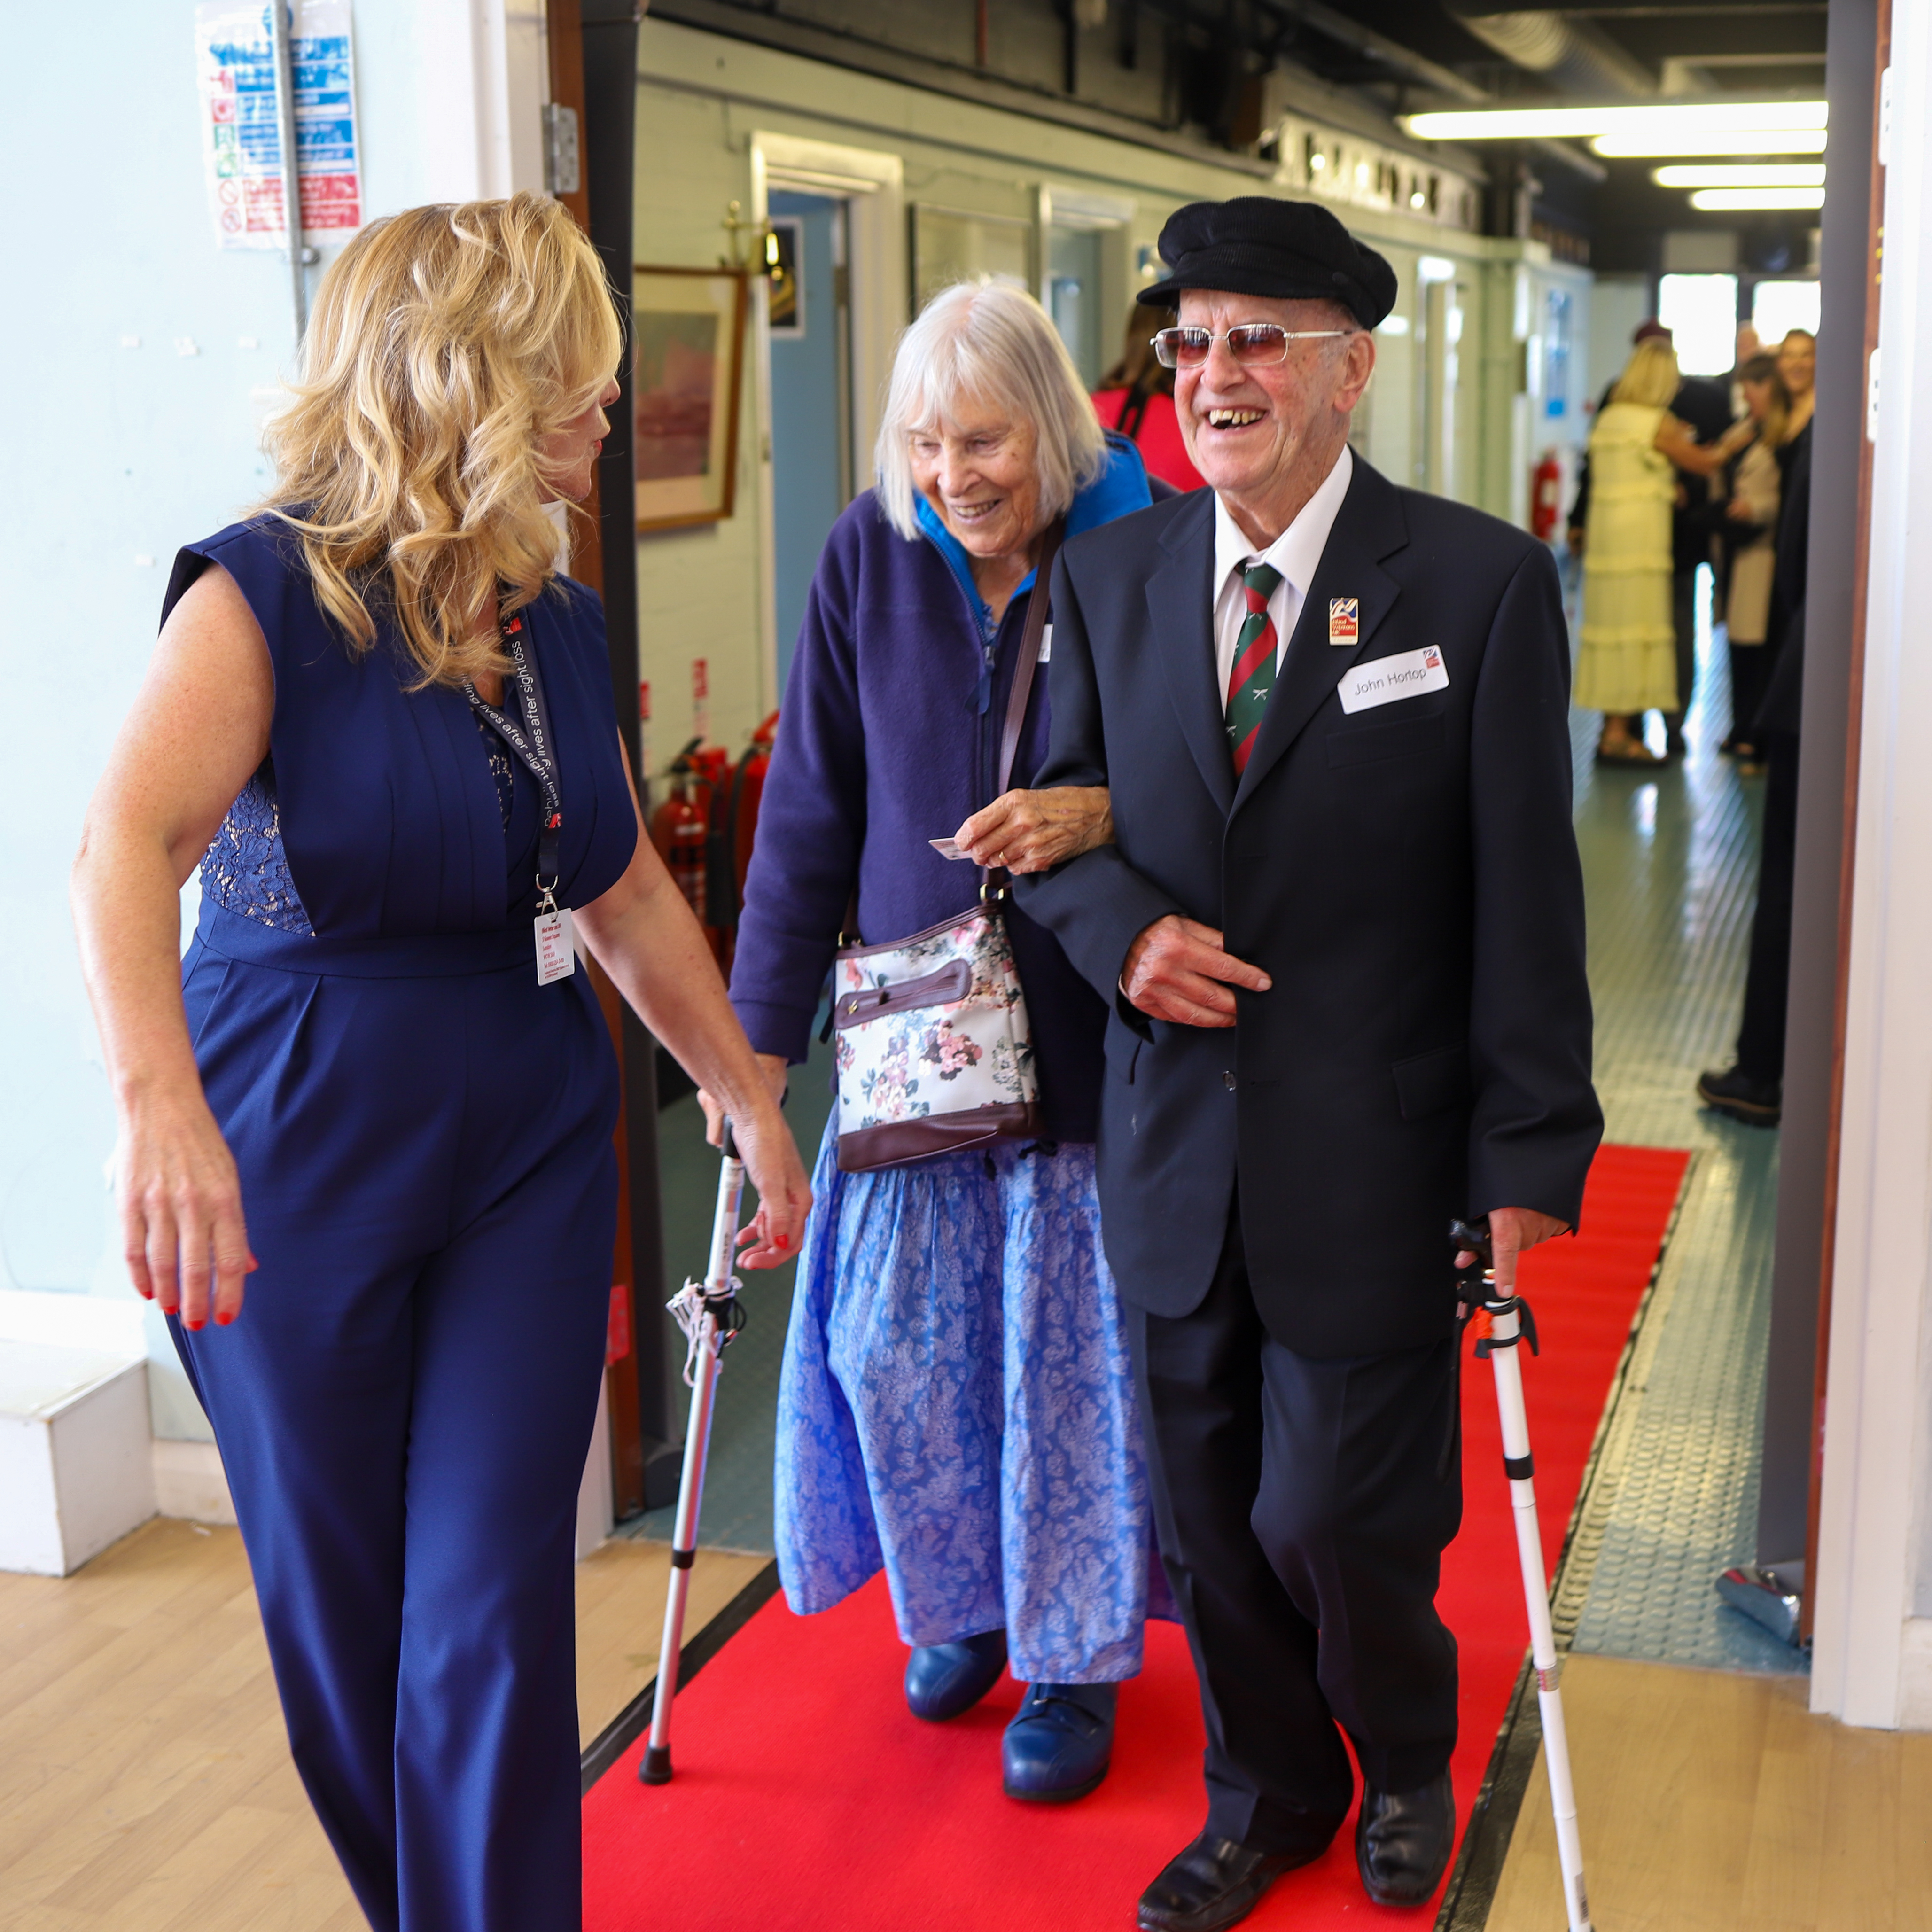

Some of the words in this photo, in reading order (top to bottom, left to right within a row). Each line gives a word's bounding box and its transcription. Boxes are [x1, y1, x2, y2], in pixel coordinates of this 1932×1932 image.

[512, 640, 525, 665] loss
[517, 664, 534, 693] sight
[1355, 679, 1385, 696] John
[1387, 668, 1427, 686] Hortop
[526, 696, 541, 726] after
[480, 704, 505, 724] lives
[502, 724, 528, 749] after
[525, 752, 549, 780] sight
[533, 729, 546, 756] lives
